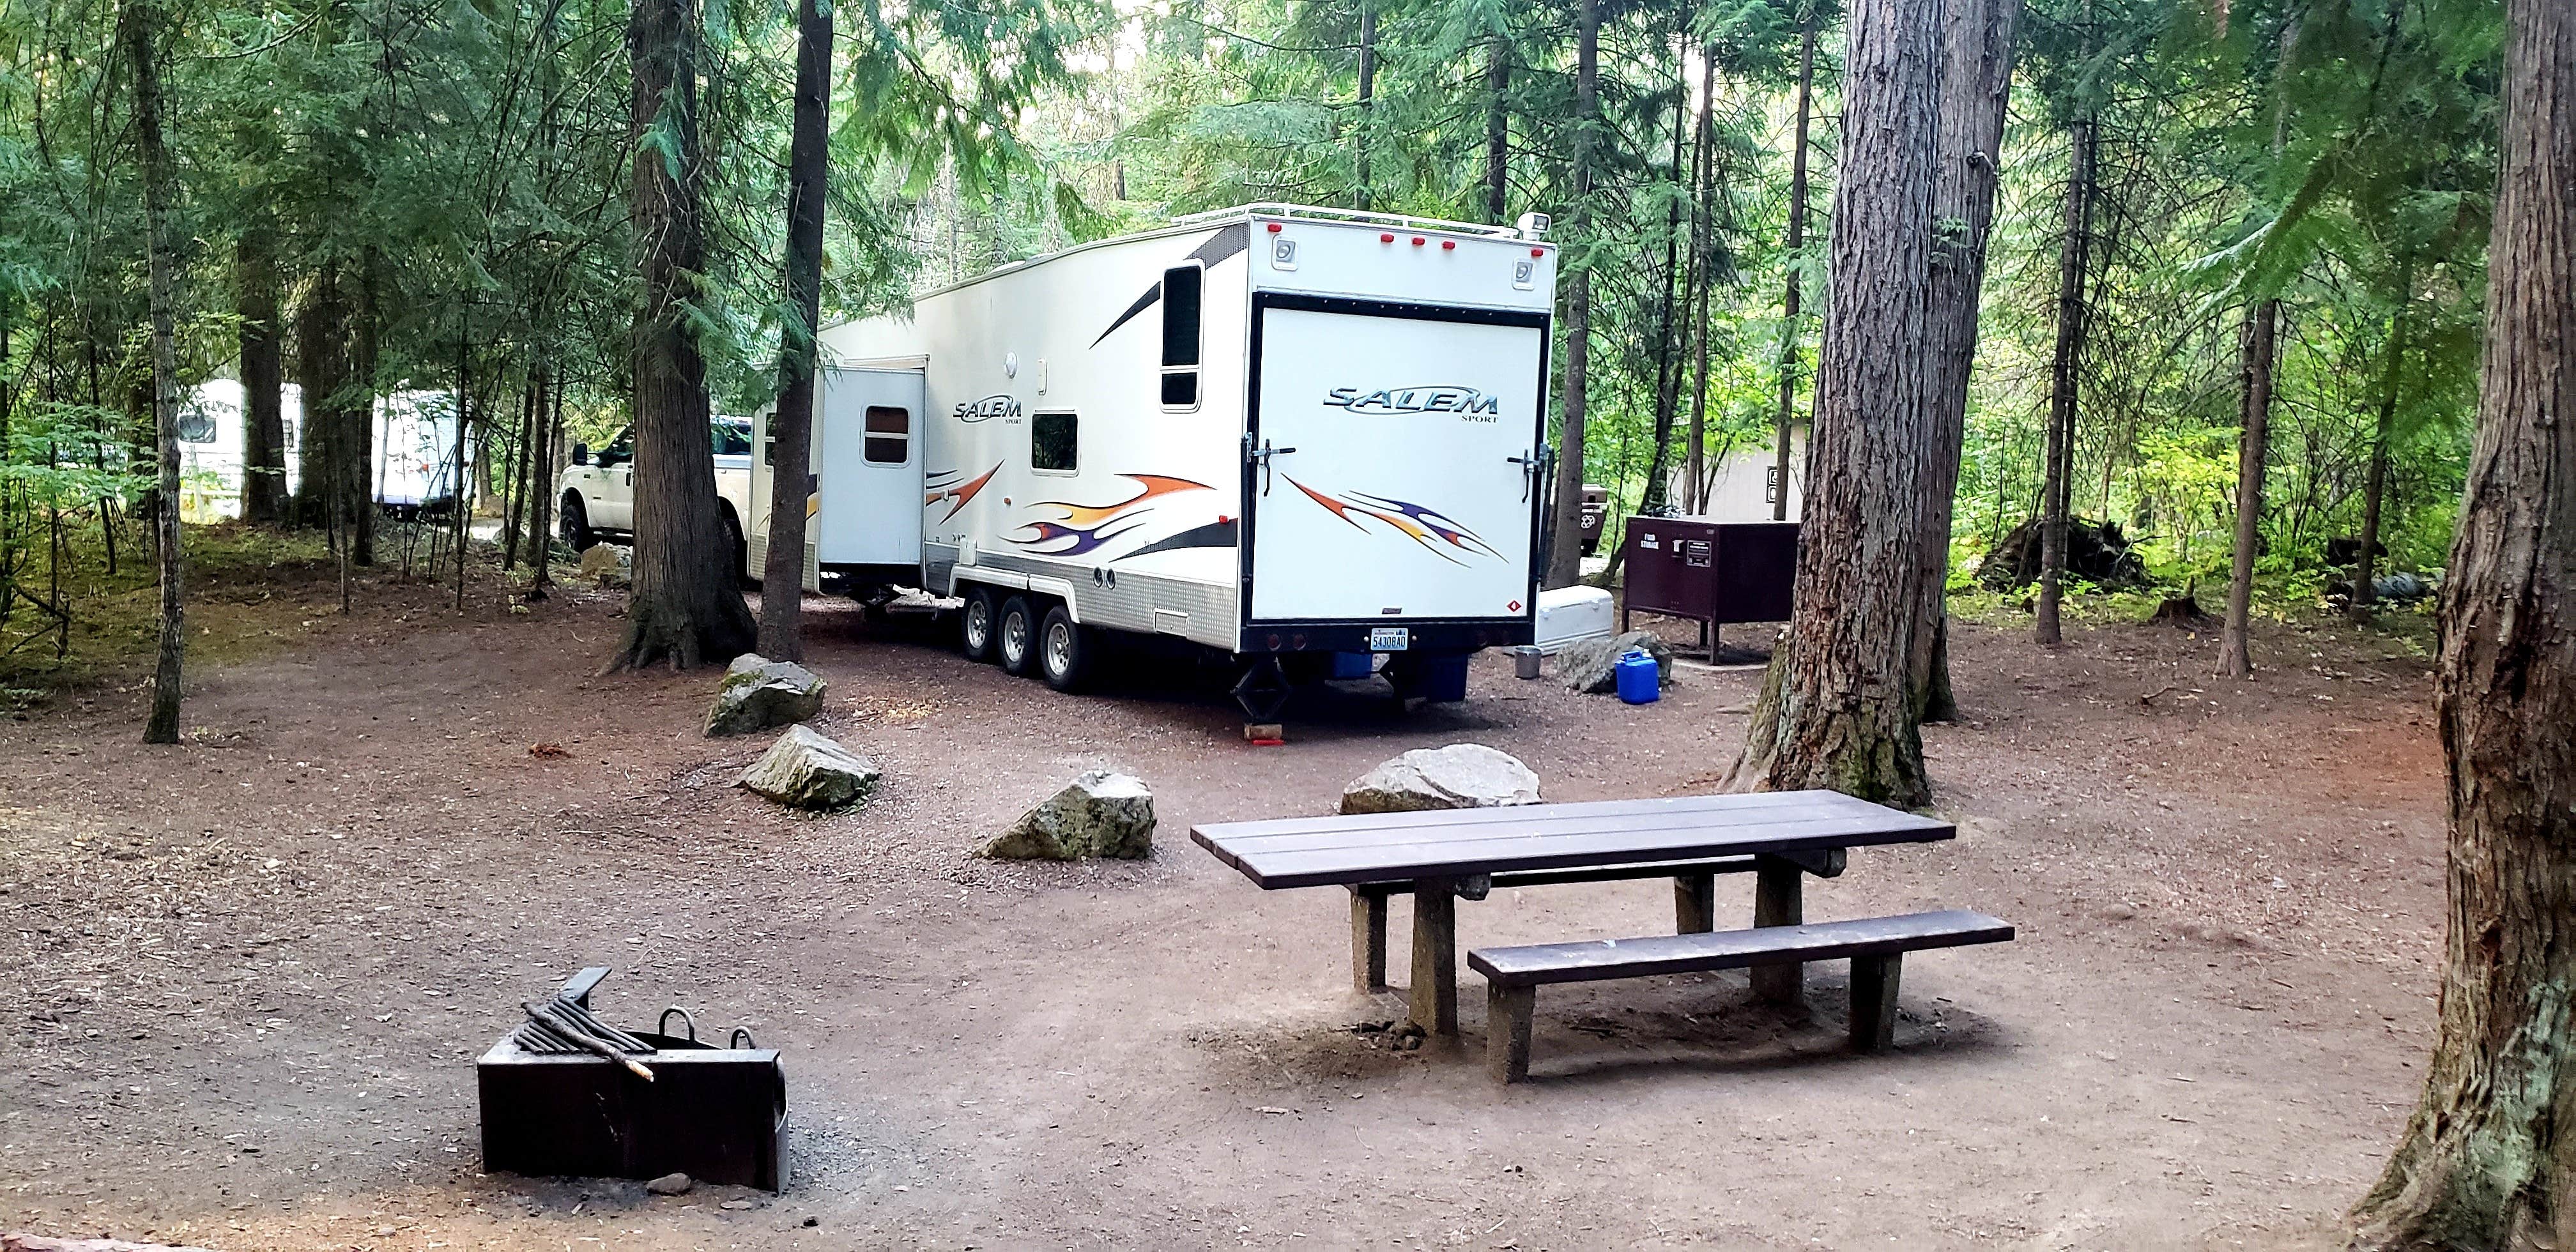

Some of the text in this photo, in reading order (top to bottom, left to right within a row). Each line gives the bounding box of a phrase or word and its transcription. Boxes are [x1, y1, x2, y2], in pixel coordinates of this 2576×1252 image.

[953, 400, 1022, 418] SALEM
[1323, 386, 1498, 415] SALEM
[1460, 415, 1498, 424] SPORT
